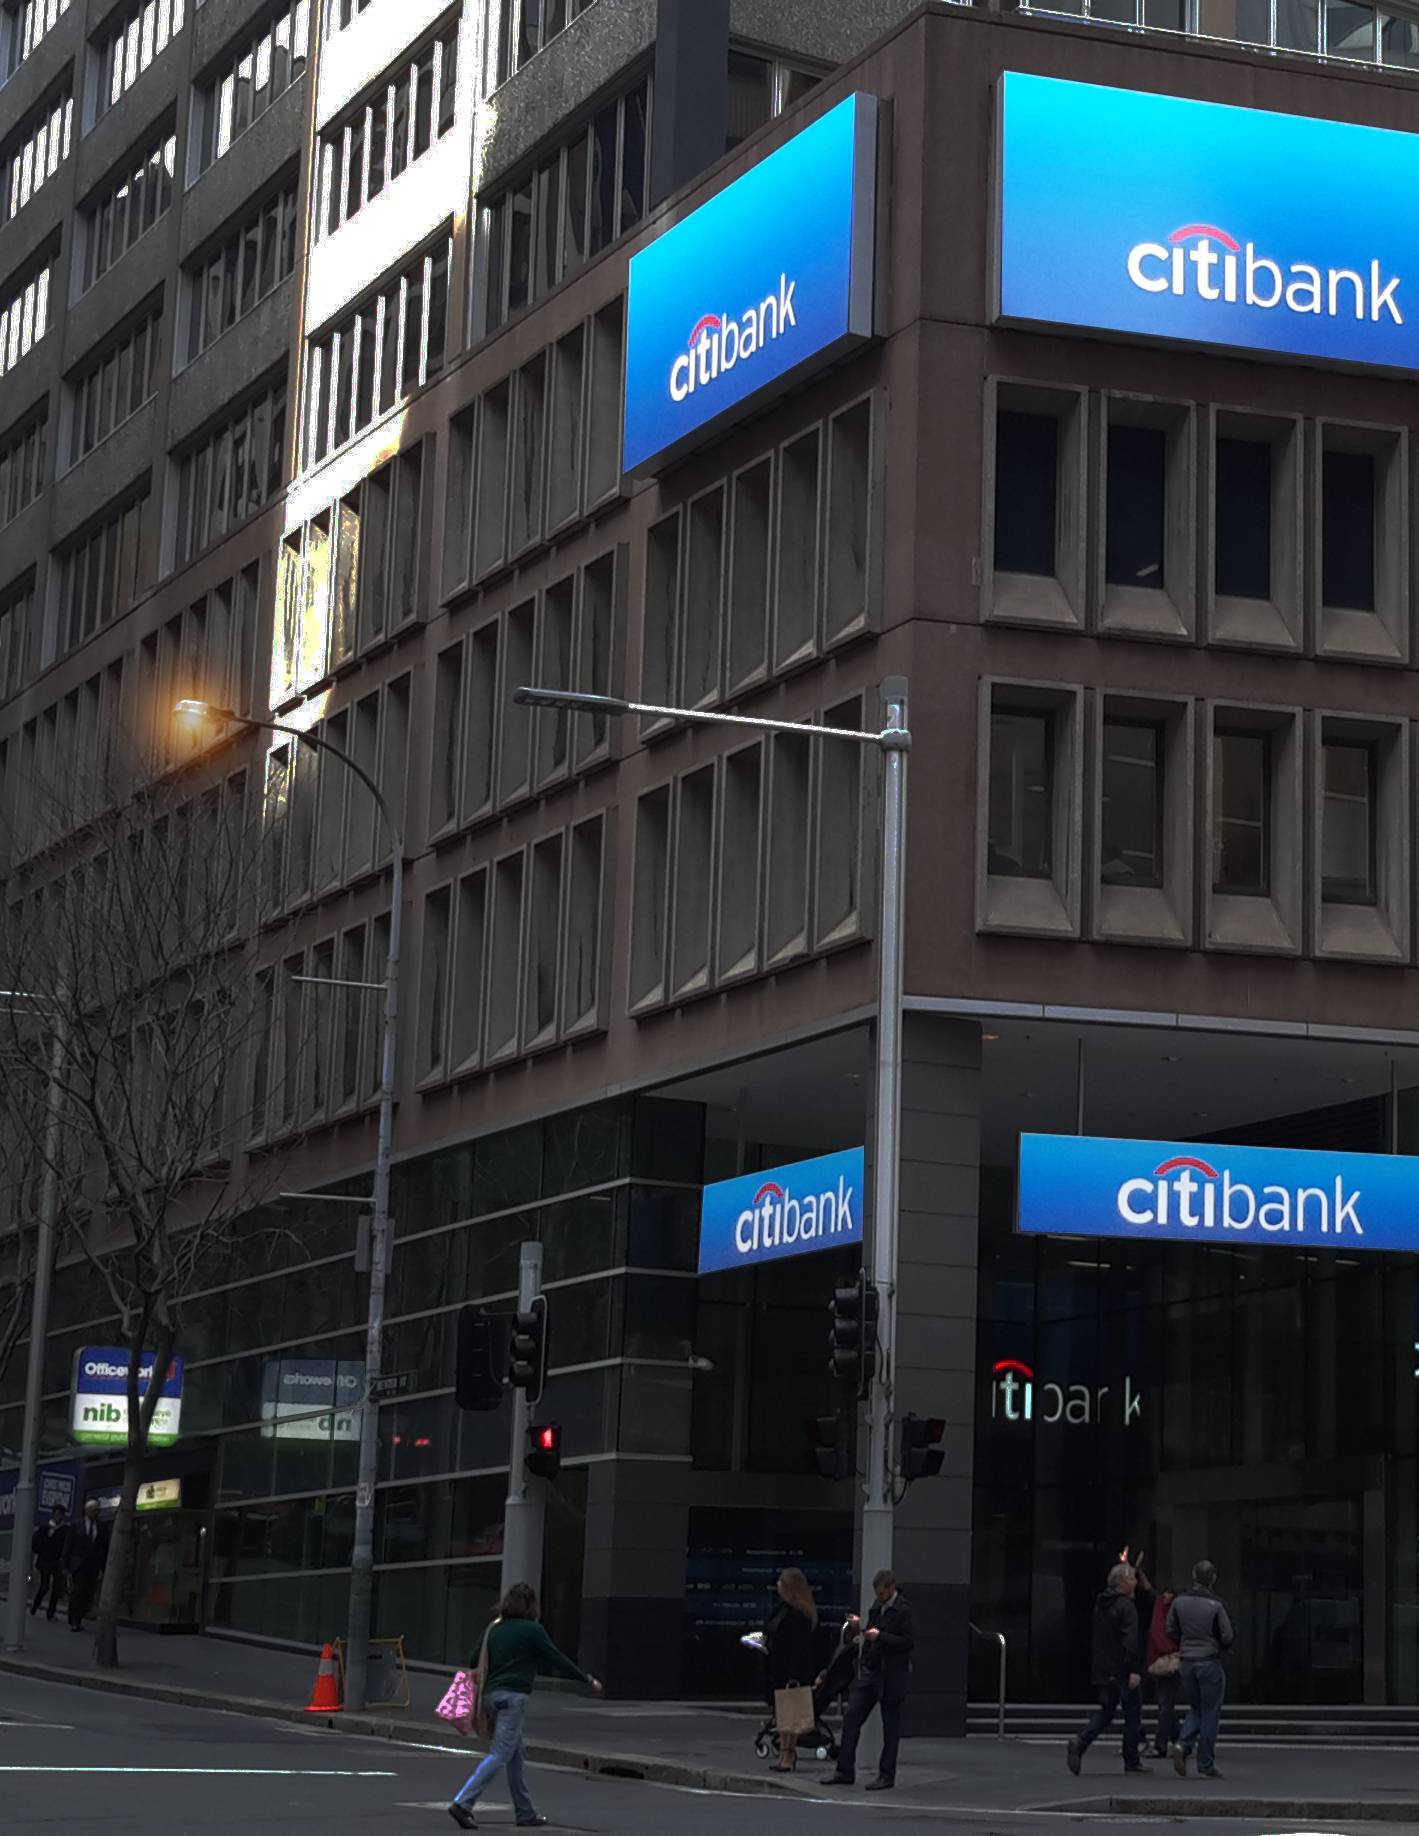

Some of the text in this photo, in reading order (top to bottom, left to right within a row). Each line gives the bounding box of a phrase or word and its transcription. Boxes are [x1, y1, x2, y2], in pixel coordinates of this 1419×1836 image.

[1126, 224, 1404, 326] citibank
[669, 271, 798, 404] citibank
[734, 1174, 855, 1254] citibank
[1116, 1156, 1364, 1236] citibank
[83, 1402, 121, 1423] nib
